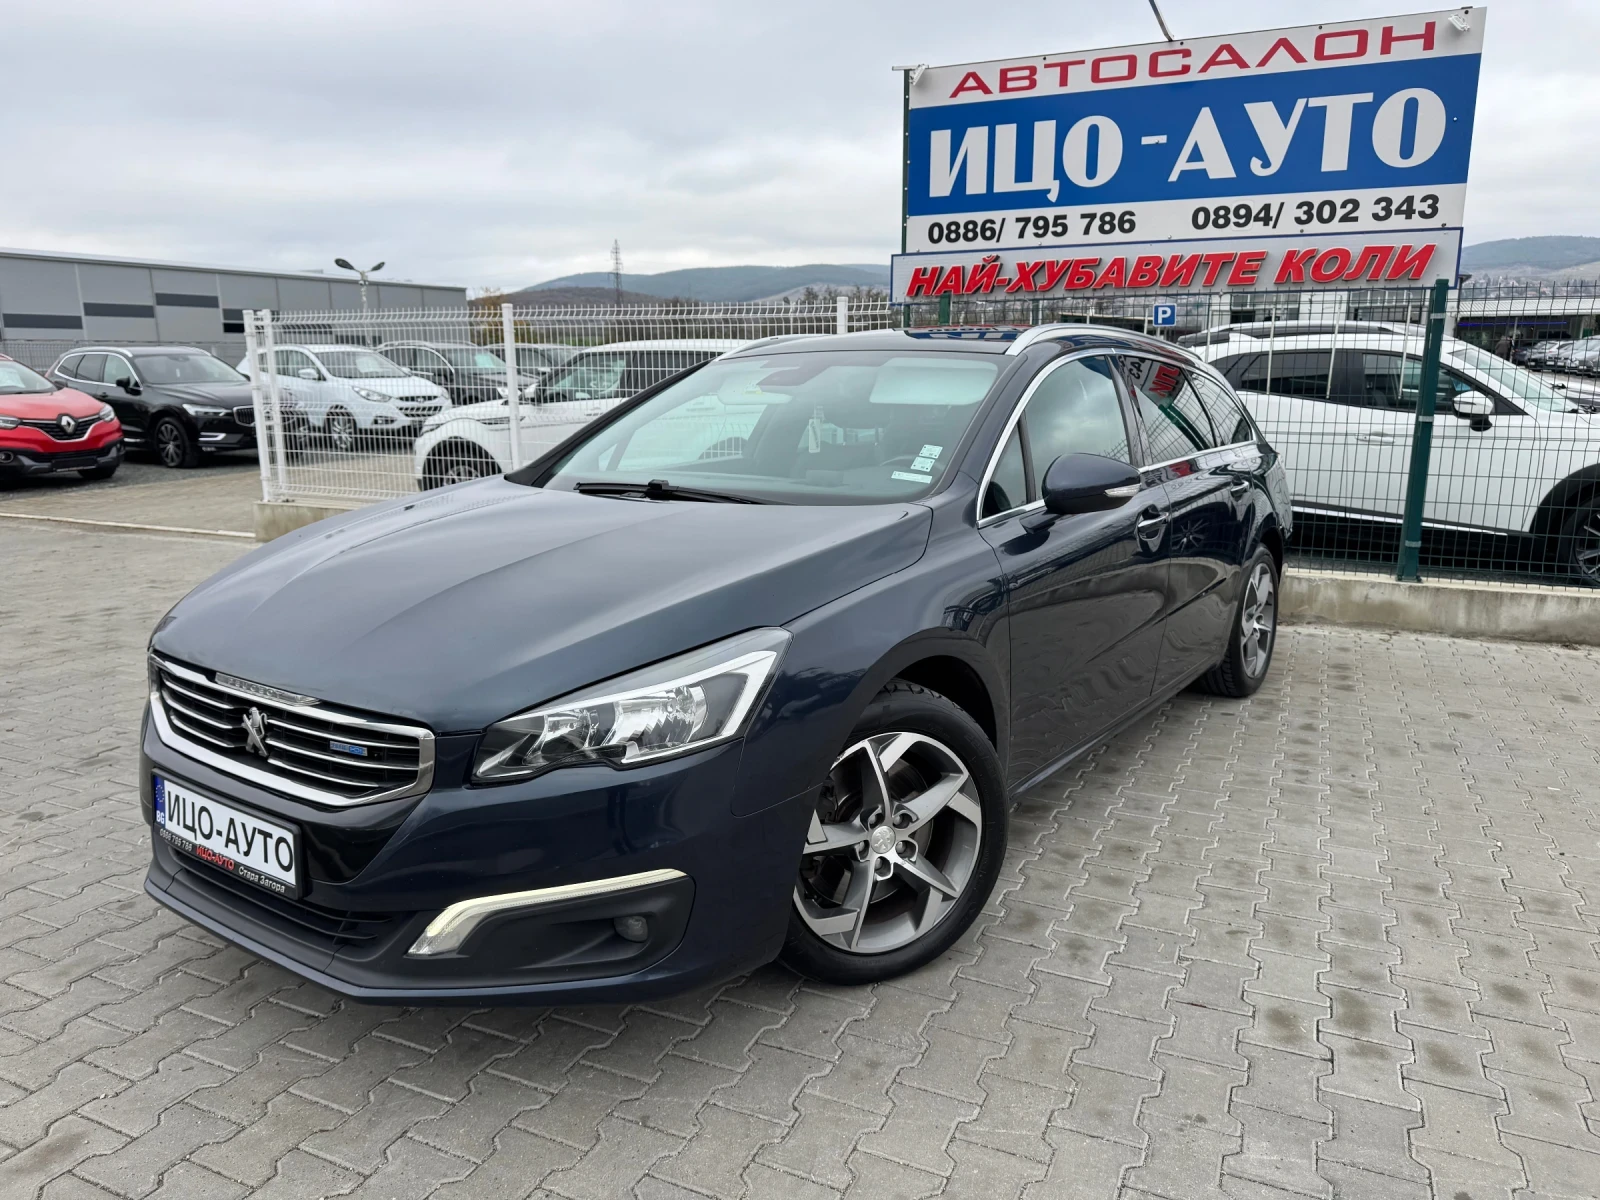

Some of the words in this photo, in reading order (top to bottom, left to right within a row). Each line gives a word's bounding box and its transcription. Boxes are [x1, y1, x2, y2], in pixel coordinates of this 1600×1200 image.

[949, 21, 1436, 99] АВТОСАЛОН
[1295, 199, 1361, 225] 302
[1371, 194, 1440, 221] 343
[1016, 214, 1069, 240] 795
[1080, 210, 1137, 236] 786
[907, 251, 1268, 297] НАЙ-ХУБАВИТЕ
[1273, 244, 1436, 284] КОЛИ
[1157, 306, 1172, 324] P
[156, 810, 165, 824] BG
[167, 790, 294, 872] ИЦО-АУТО
[196, 844, 235, 871] ИЦО-АУТО
[238, 866, 259, 883] Стара
[260, 875, 285, 893] Загора
